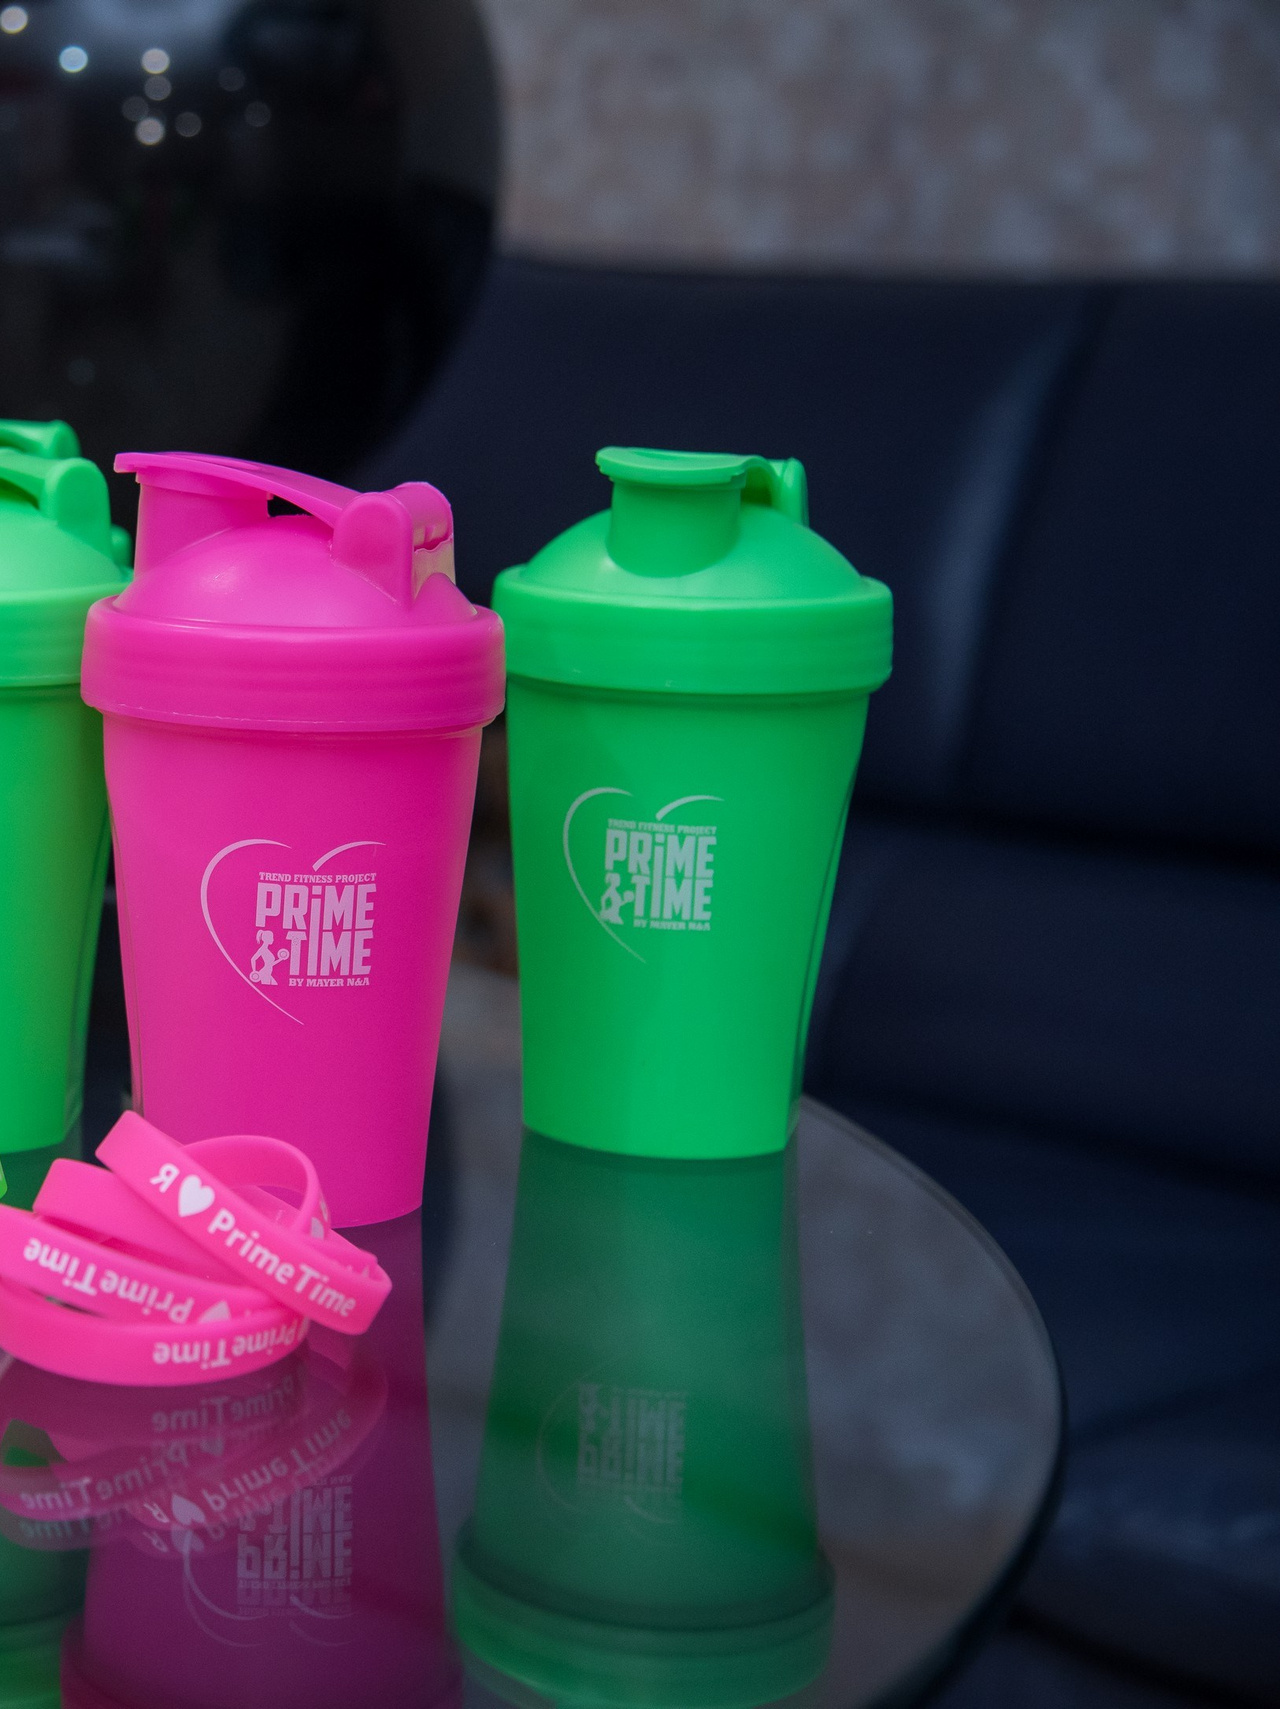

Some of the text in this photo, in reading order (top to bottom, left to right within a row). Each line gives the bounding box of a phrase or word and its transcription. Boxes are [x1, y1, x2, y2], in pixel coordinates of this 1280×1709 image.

[259, 872, 377, 884] TREND FITNESS PROJECT
[288, 977, 370, 987] BY MAYER N&A
[23, 1238, 195, 1325] PrimeTime
[207, 1208, 357, 1318] PrimeTime
